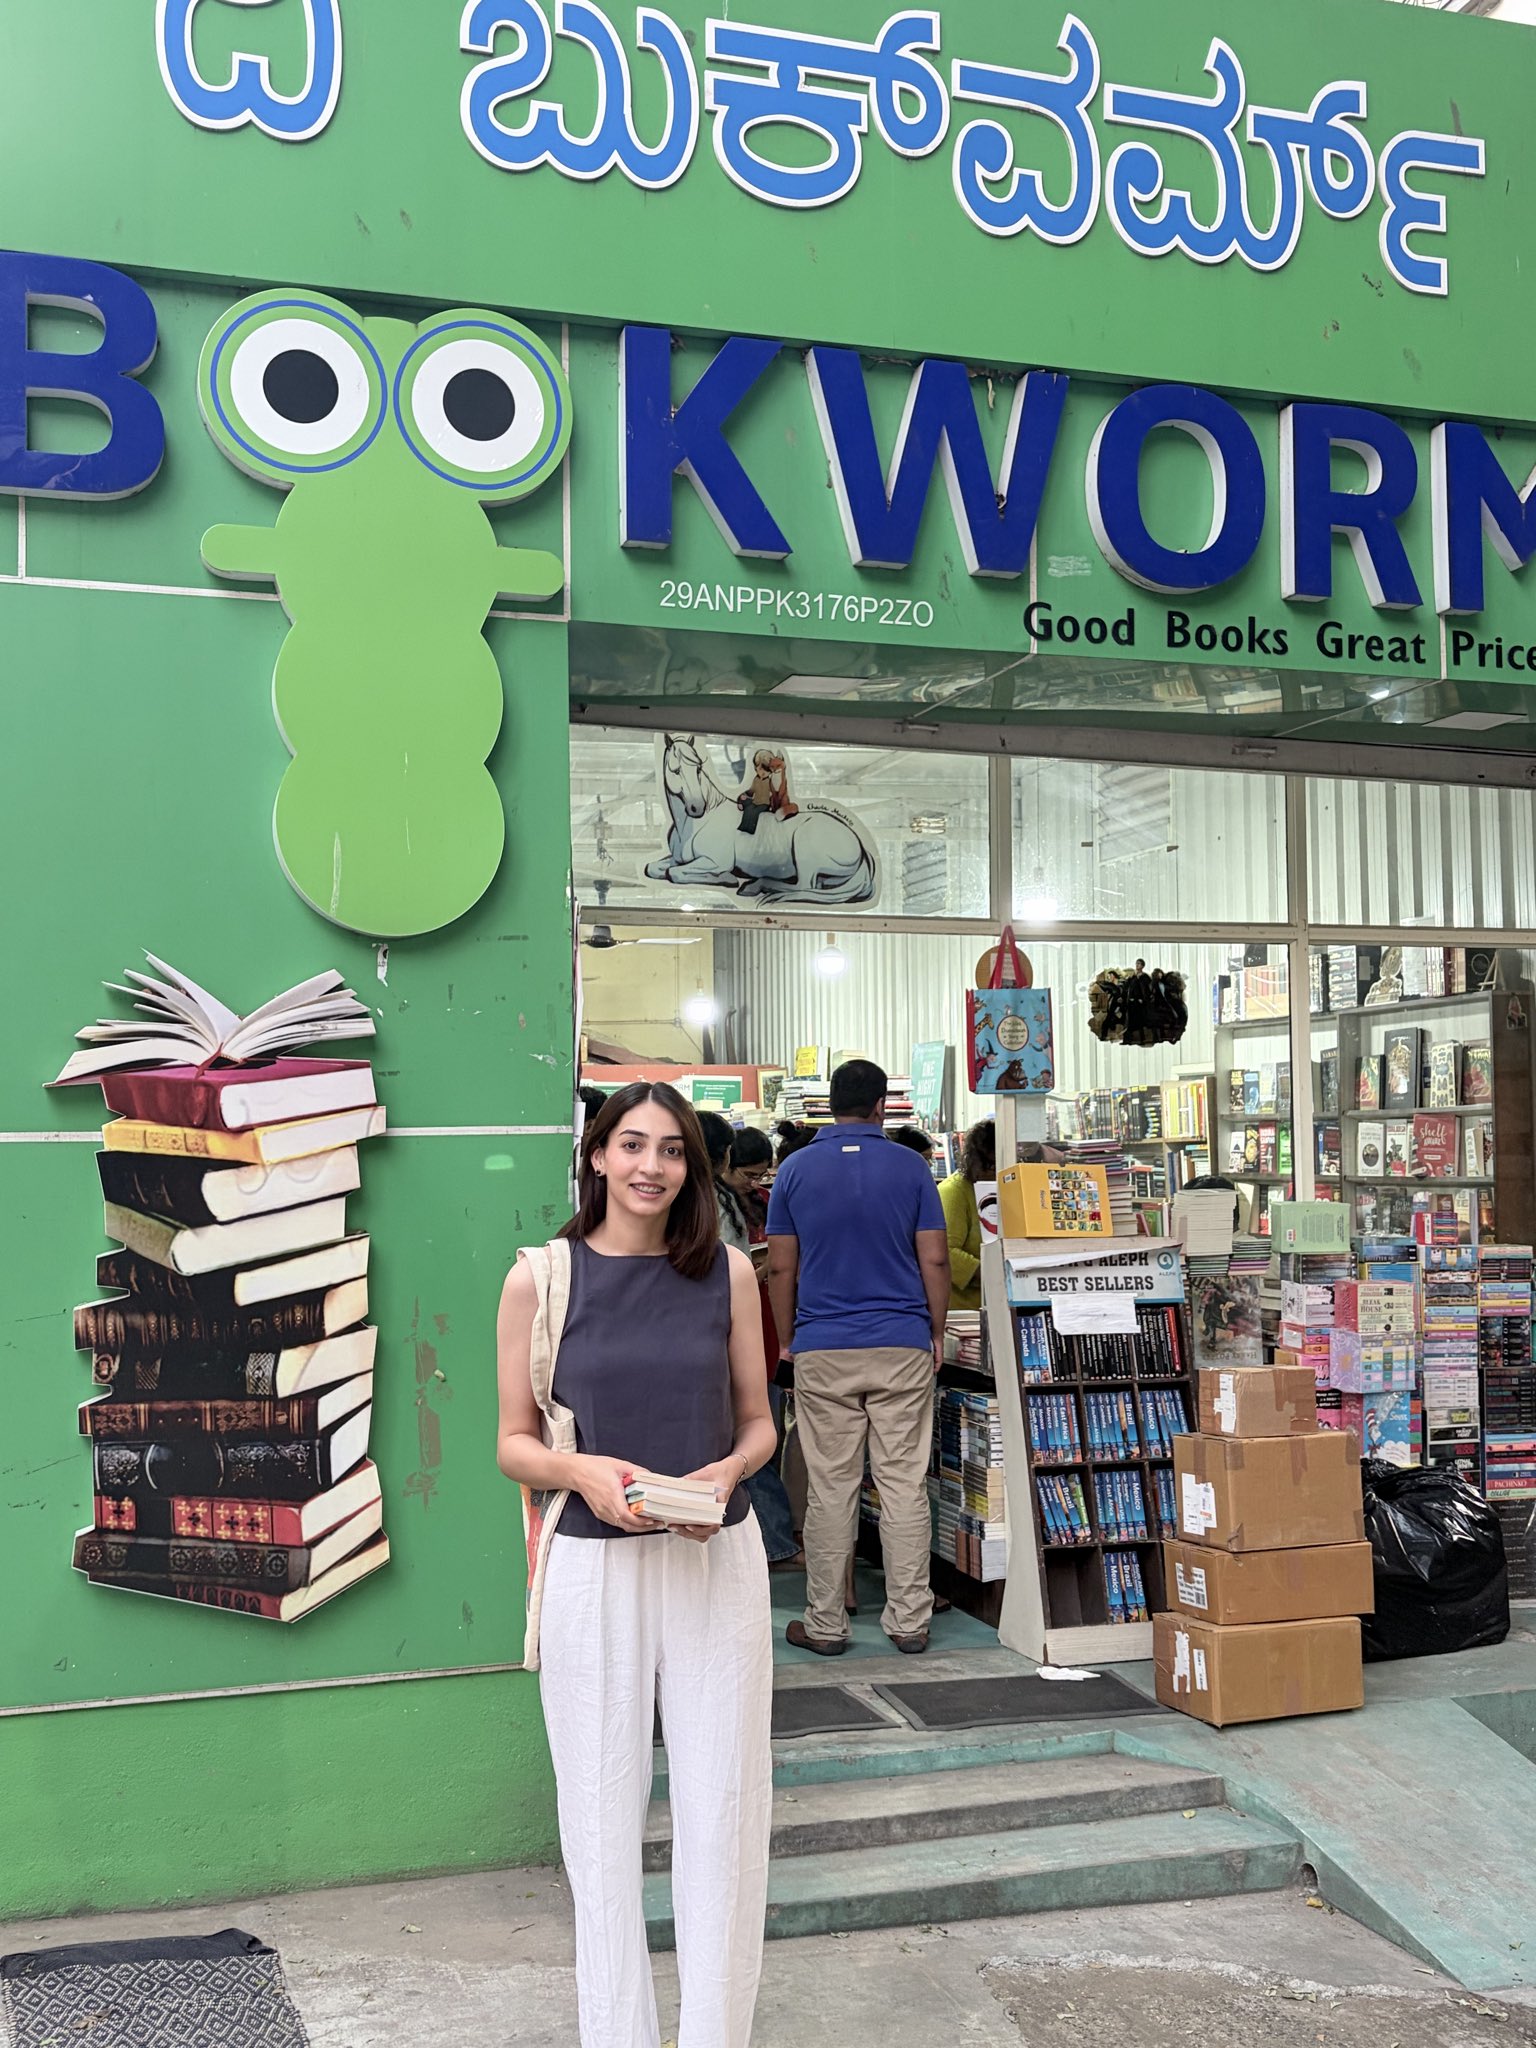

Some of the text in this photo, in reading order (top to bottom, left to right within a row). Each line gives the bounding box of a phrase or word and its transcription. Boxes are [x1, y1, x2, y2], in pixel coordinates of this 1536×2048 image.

[1023, 600, 1136, 647] Good
[1166, 610, 1290, 657] Books
[1316, 620, 1427, 664] Great
[1037, 1275, 1154, 1292] BEST SELLERS
[1021, 1329, 1030, 1357] Canada
[1126, 1404, 1135, 1424] Brazil
[1146, 1403, 1155, 1429] Mexico
[1494, 1480, 1527, 1488] PACHINKO
[1063, 1487, 1074, 1509] Brazil
[1133, 1483, 1141, 1510] Mexico
[1110, 1565, 1119, 1593] Mexico
[1123, 1565, 1132, 1587] Brazil
